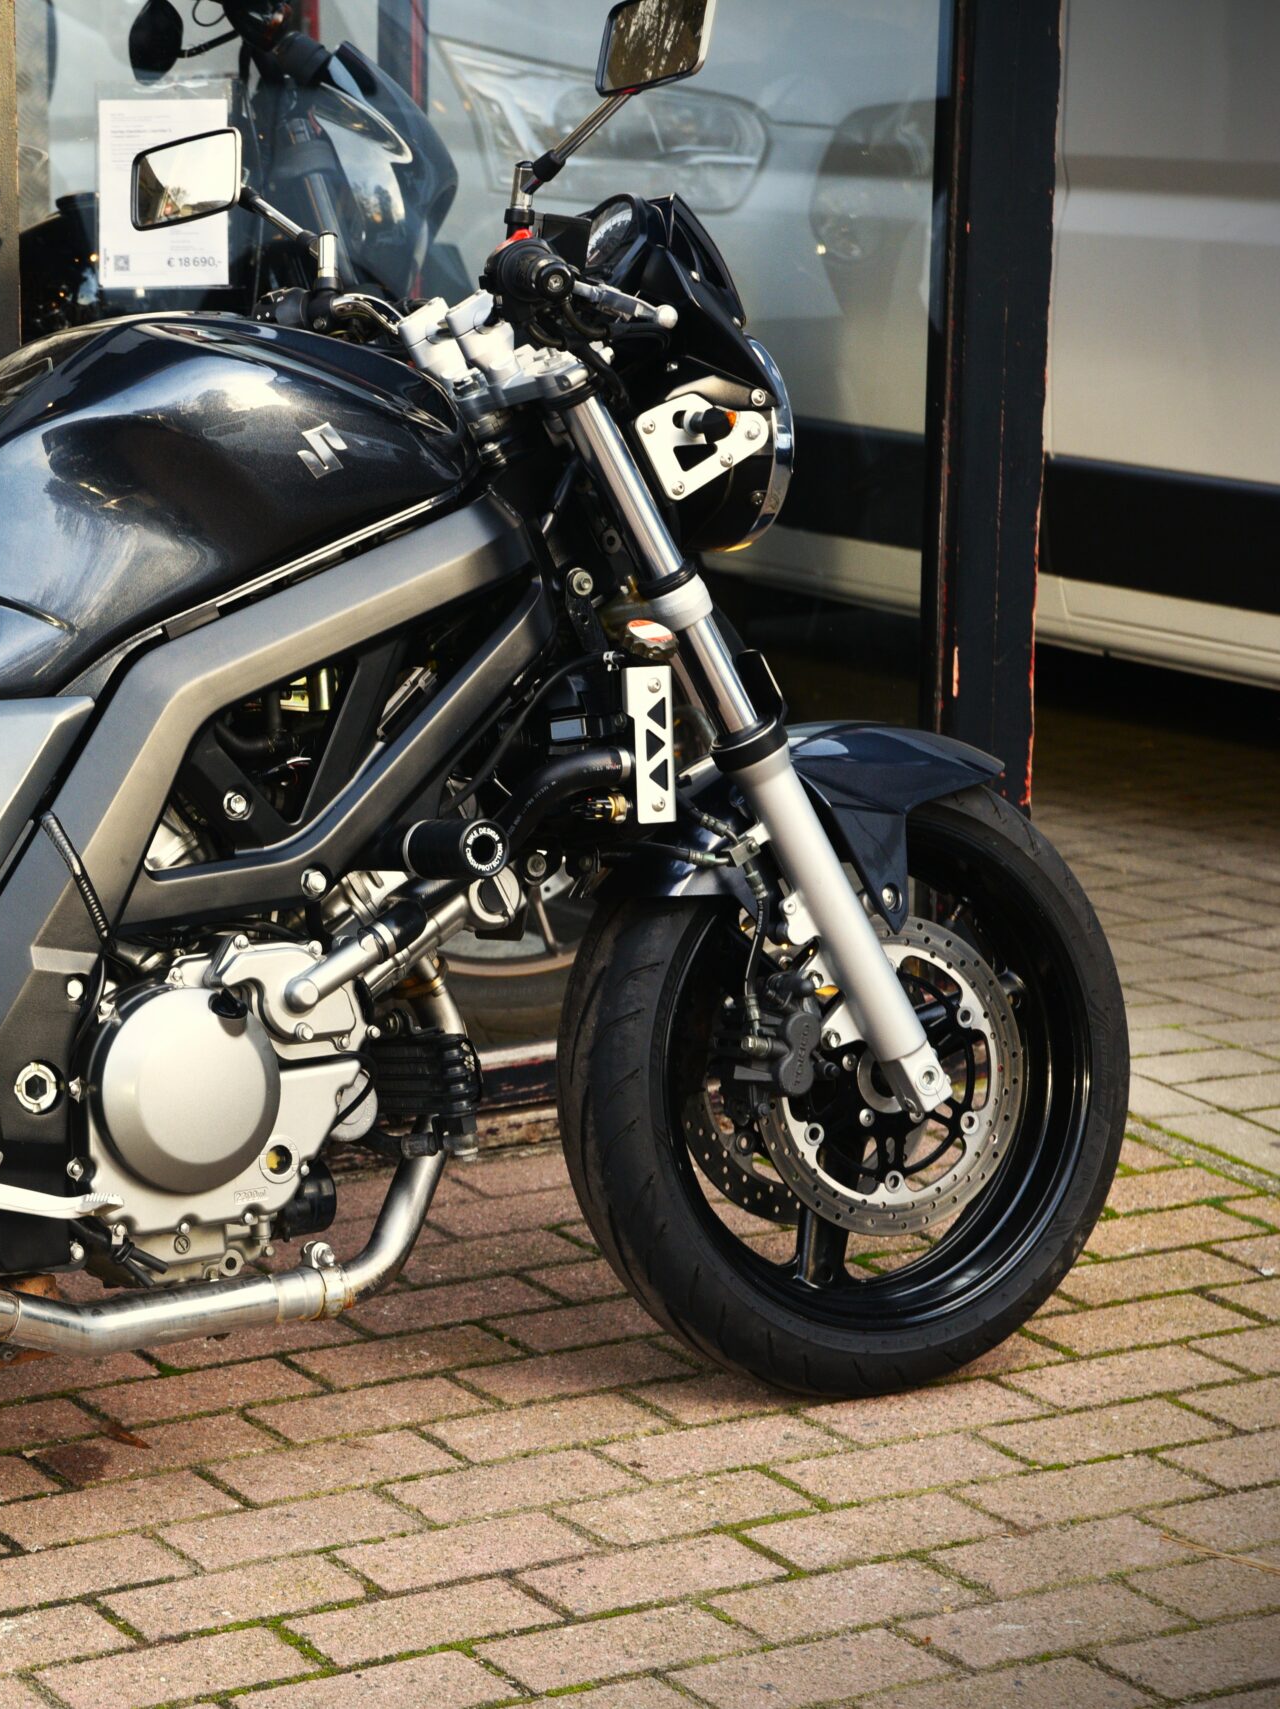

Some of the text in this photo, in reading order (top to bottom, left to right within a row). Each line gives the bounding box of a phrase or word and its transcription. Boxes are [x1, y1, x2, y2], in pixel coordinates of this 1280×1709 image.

[167, 256, 175, 267] €
[467, 827, 500, 845] BIKE DESIGN
[465, 842, 503, 871] CRASH PROTECTION
